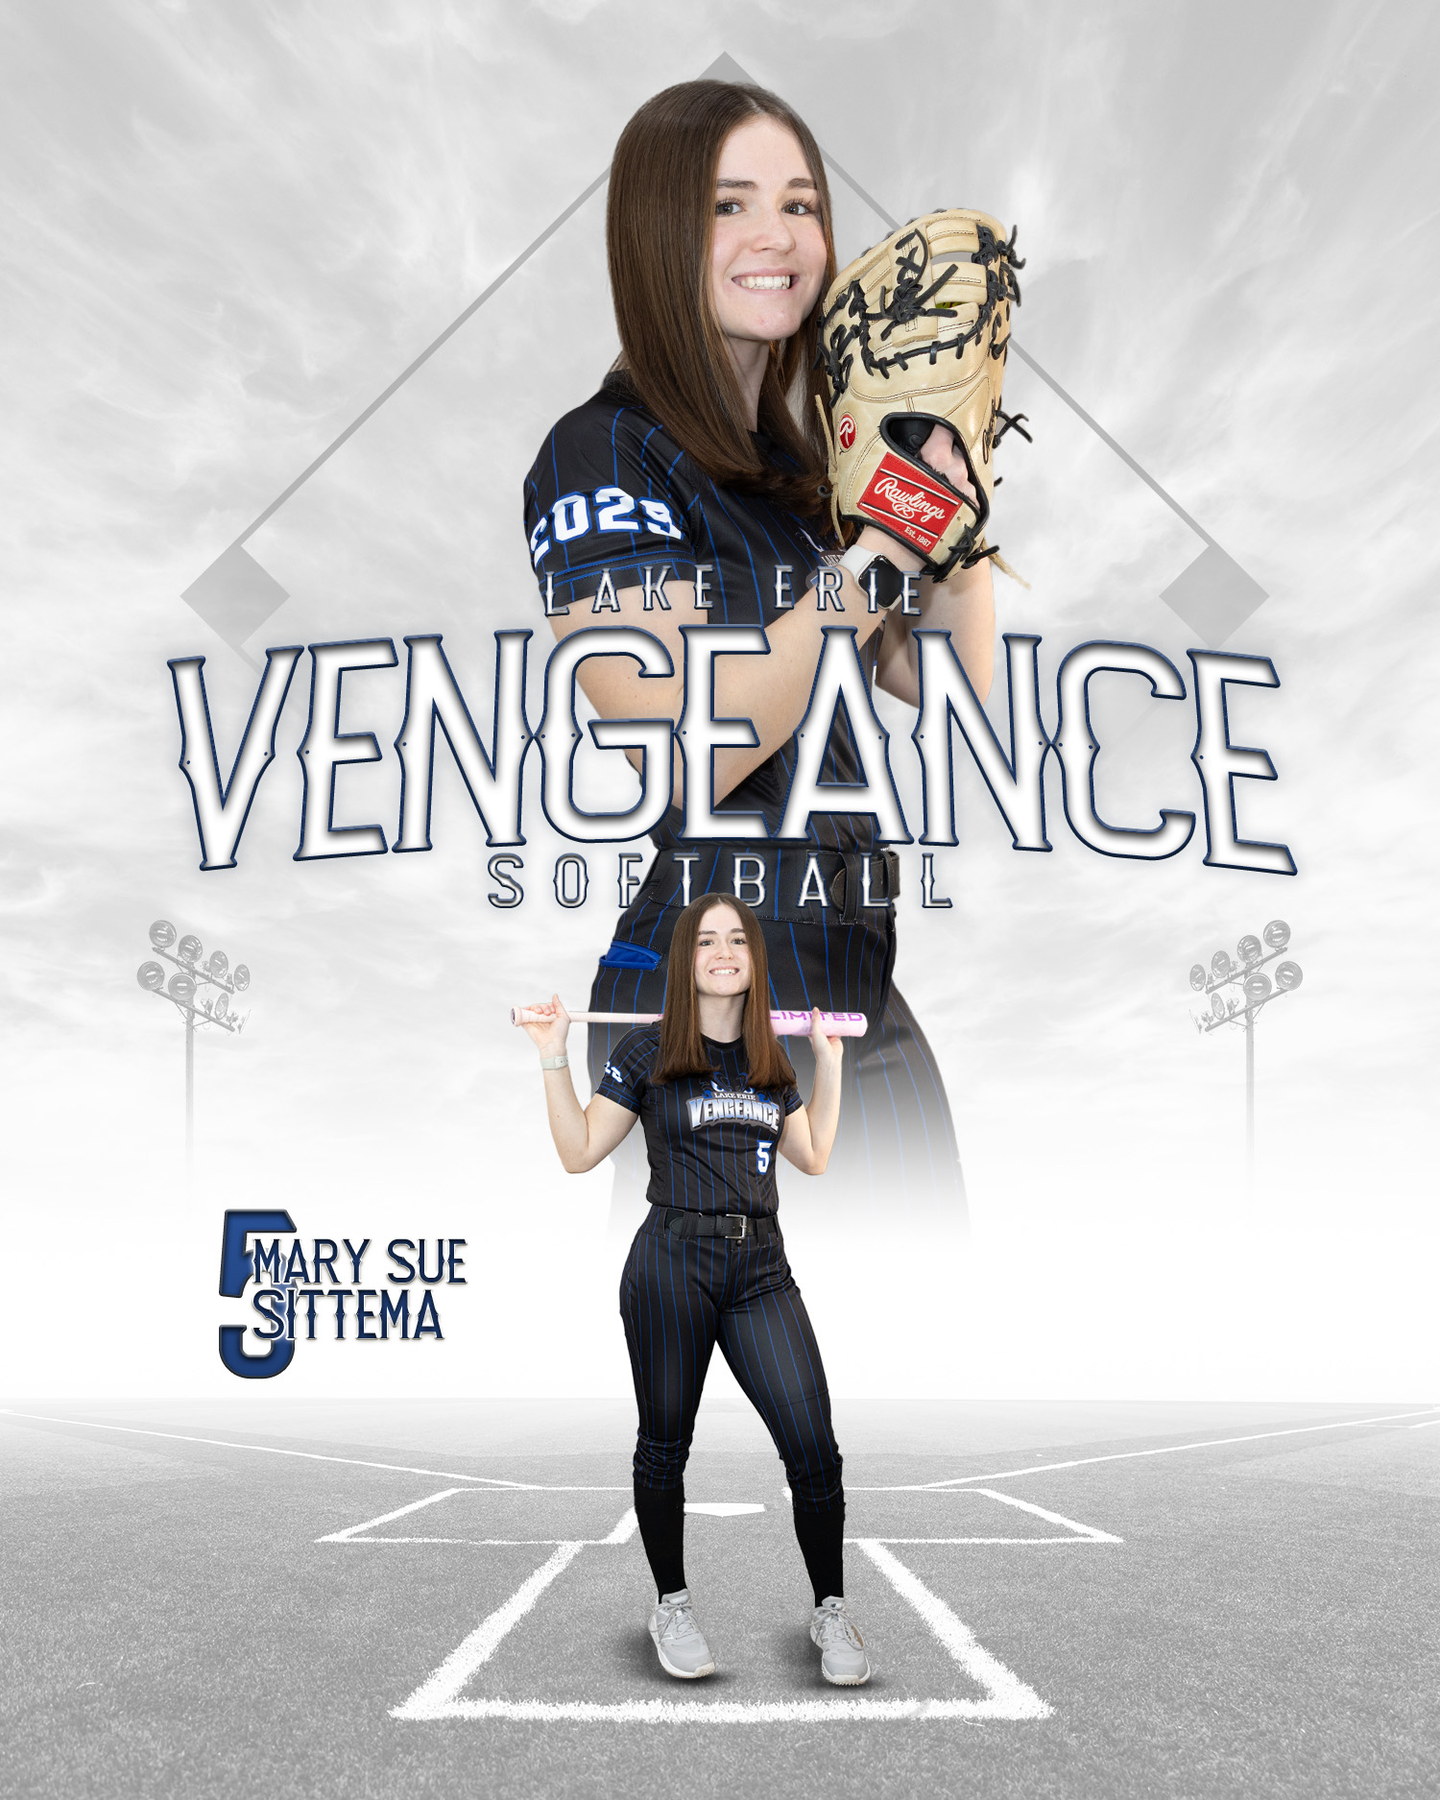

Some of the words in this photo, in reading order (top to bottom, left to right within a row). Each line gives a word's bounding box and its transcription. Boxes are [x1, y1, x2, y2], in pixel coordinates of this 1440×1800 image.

[874, 477, 946, 523] Rawlings
[529, 484, 685, 569] 2029
[688, 1097, 780, 1132] VENGEANCE
[757, 1140, 774, 1175] 5
